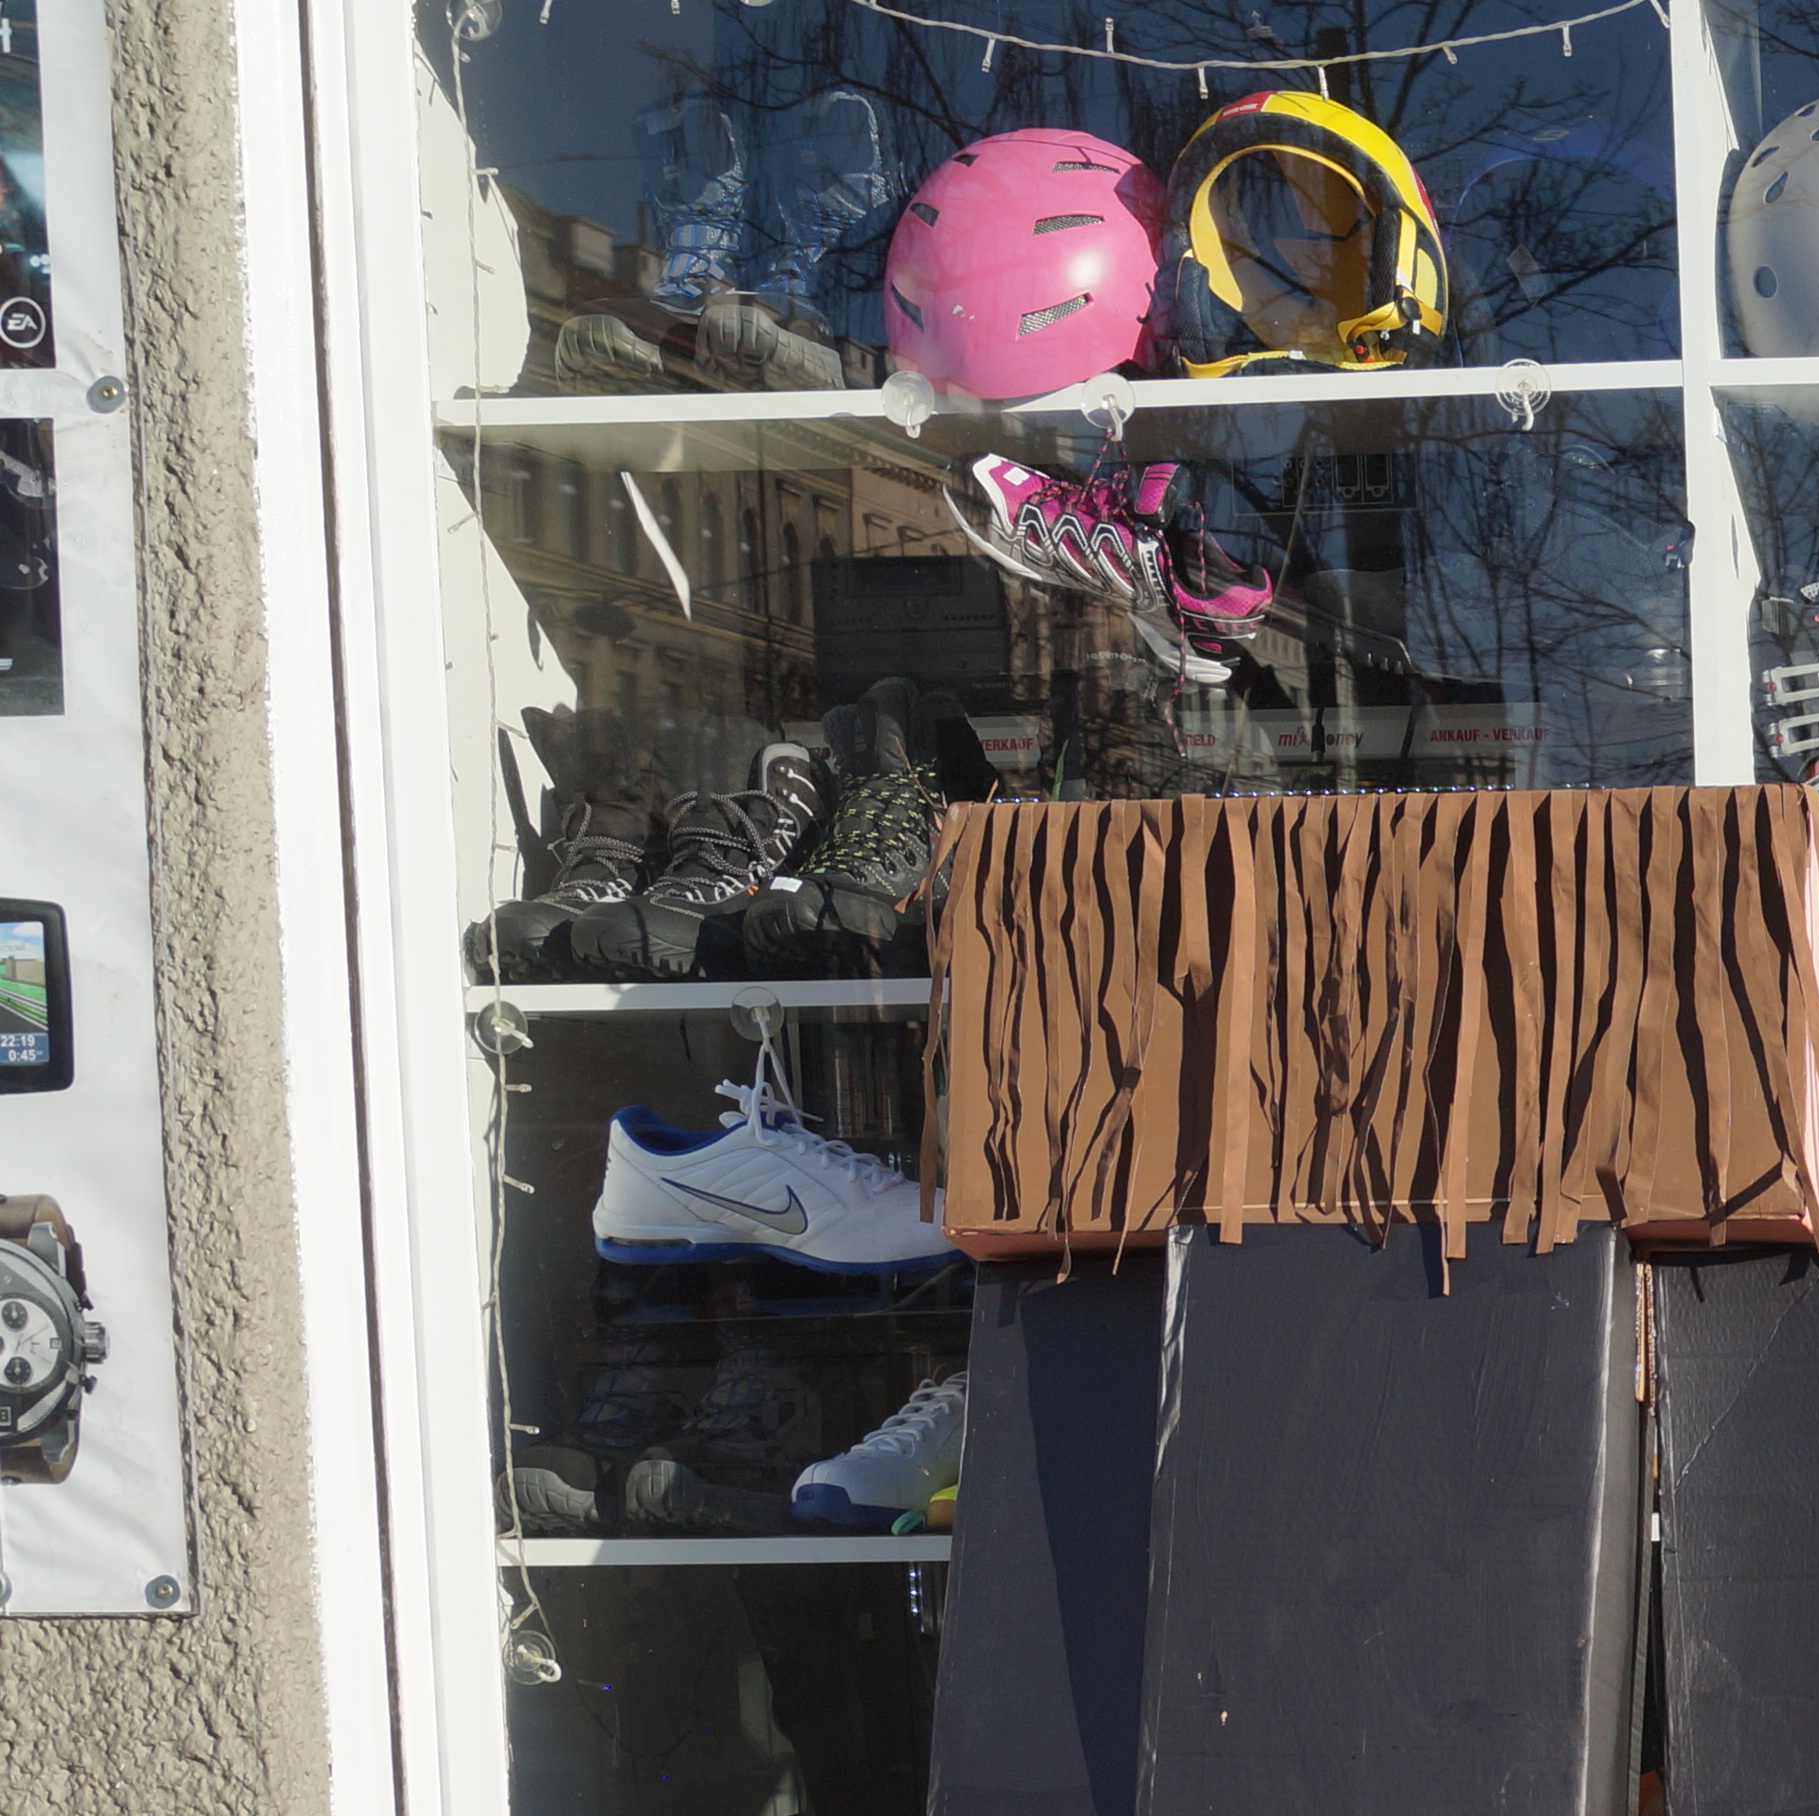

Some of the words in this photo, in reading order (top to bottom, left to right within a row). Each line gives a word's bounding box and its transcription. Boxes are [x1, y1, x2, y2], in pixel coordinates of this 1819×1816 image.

[7, 313, 39, 331] EA
[1430, 729, 1480, 742] ANKAUF
[1496, 727, 1550, 741] VERKAUF
[1, 1034, 36, 1048] 22:19
